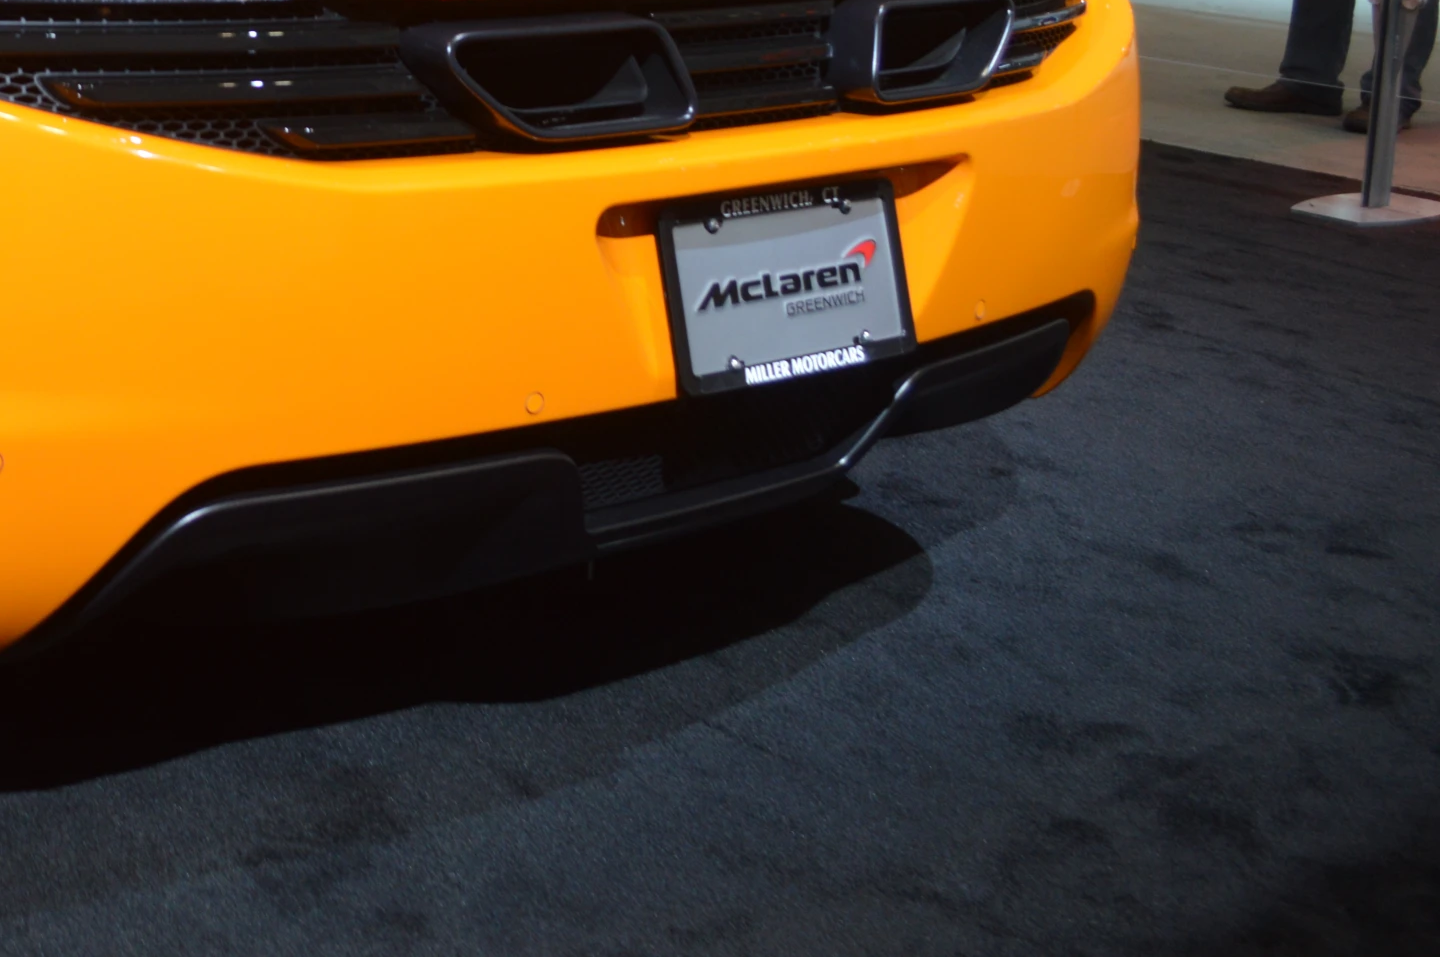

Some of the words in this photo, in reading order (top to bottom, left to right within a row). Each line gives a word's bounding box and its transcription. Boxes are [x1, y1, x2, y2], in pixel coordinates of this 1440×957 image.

[821, 186, 840, 204] CT
[696, 261, 862, 312] McLaren
[786, 291, 866, 317] GREENWICH
[745, 359, 791, 386] MILLER
[791, 344, 866, 377] MOTORCARS
